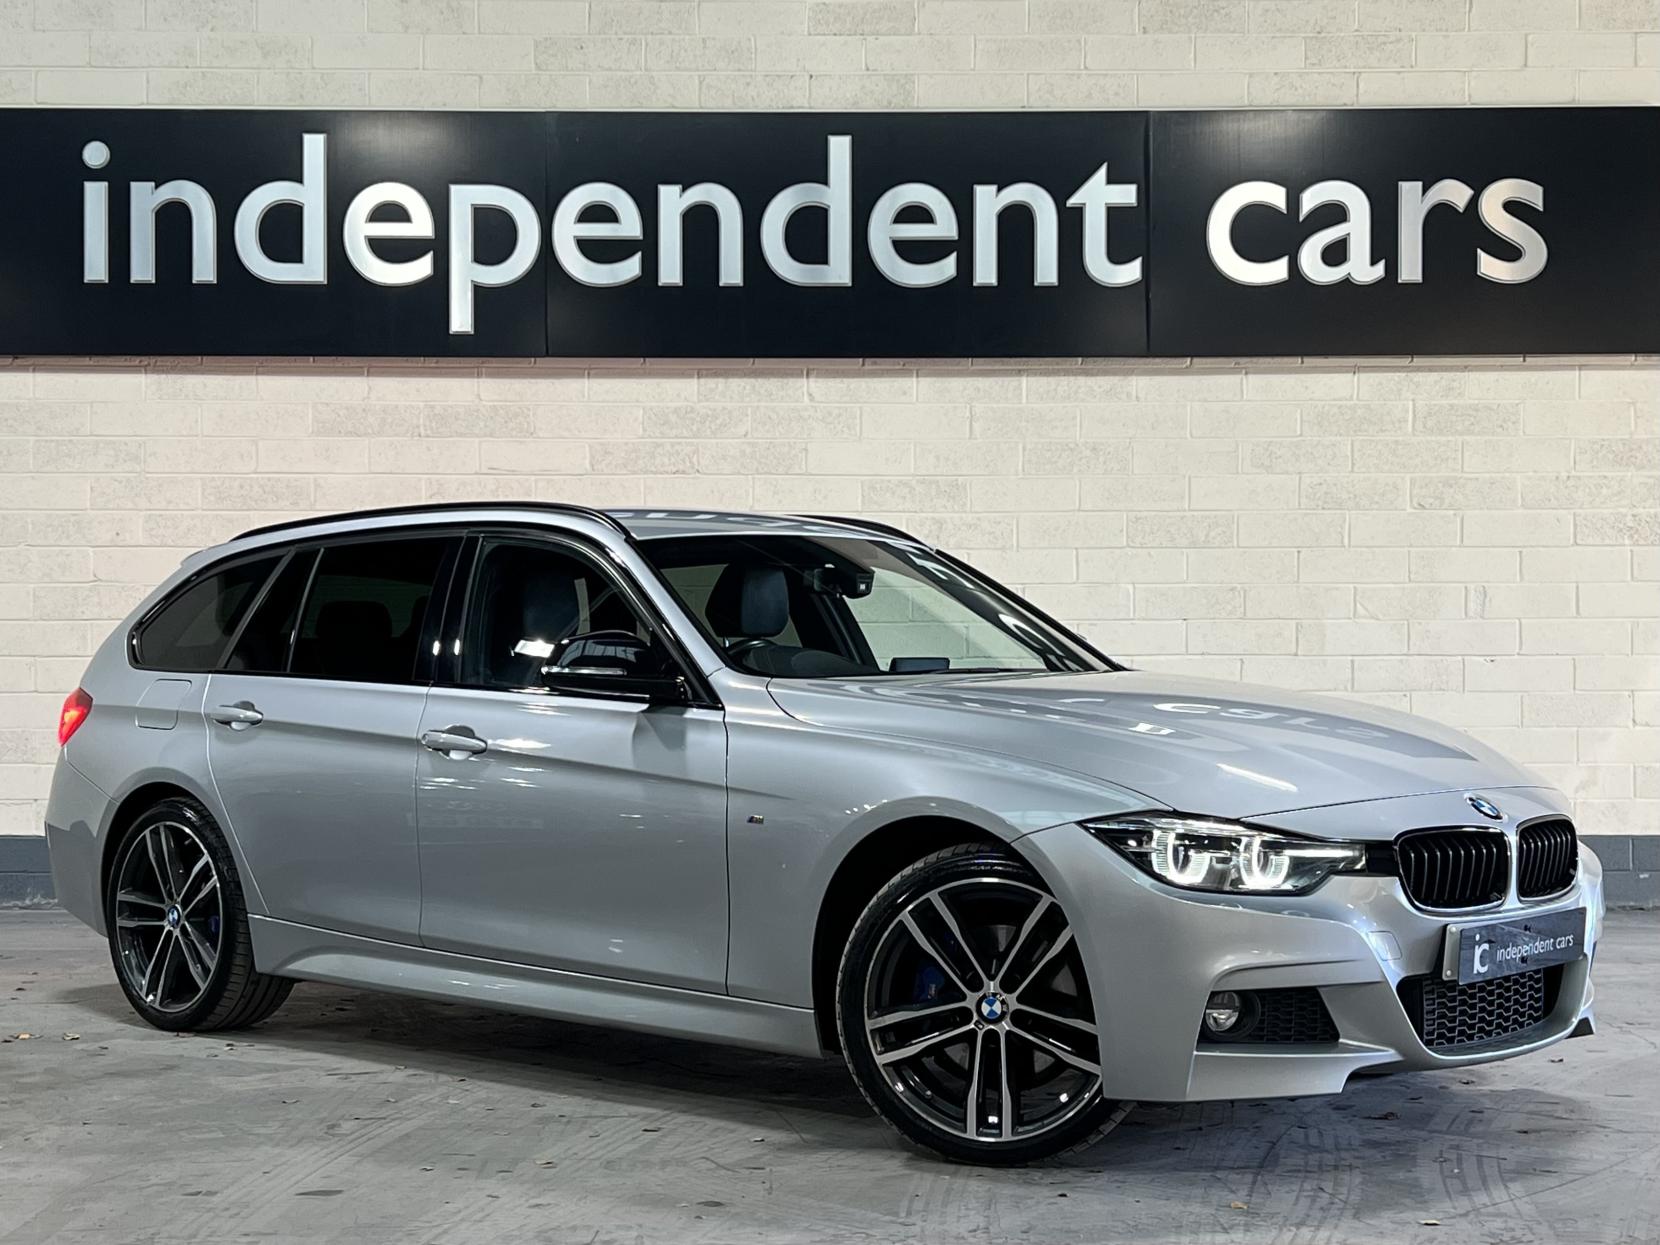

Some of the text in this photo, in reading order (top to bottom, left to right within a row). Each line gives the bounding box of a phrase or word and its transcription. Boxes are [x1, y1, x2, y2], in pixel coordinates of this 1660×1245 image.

[82, 133, 1548, 335] independent cars
[1496, 934, 1575, 963] independent cars
